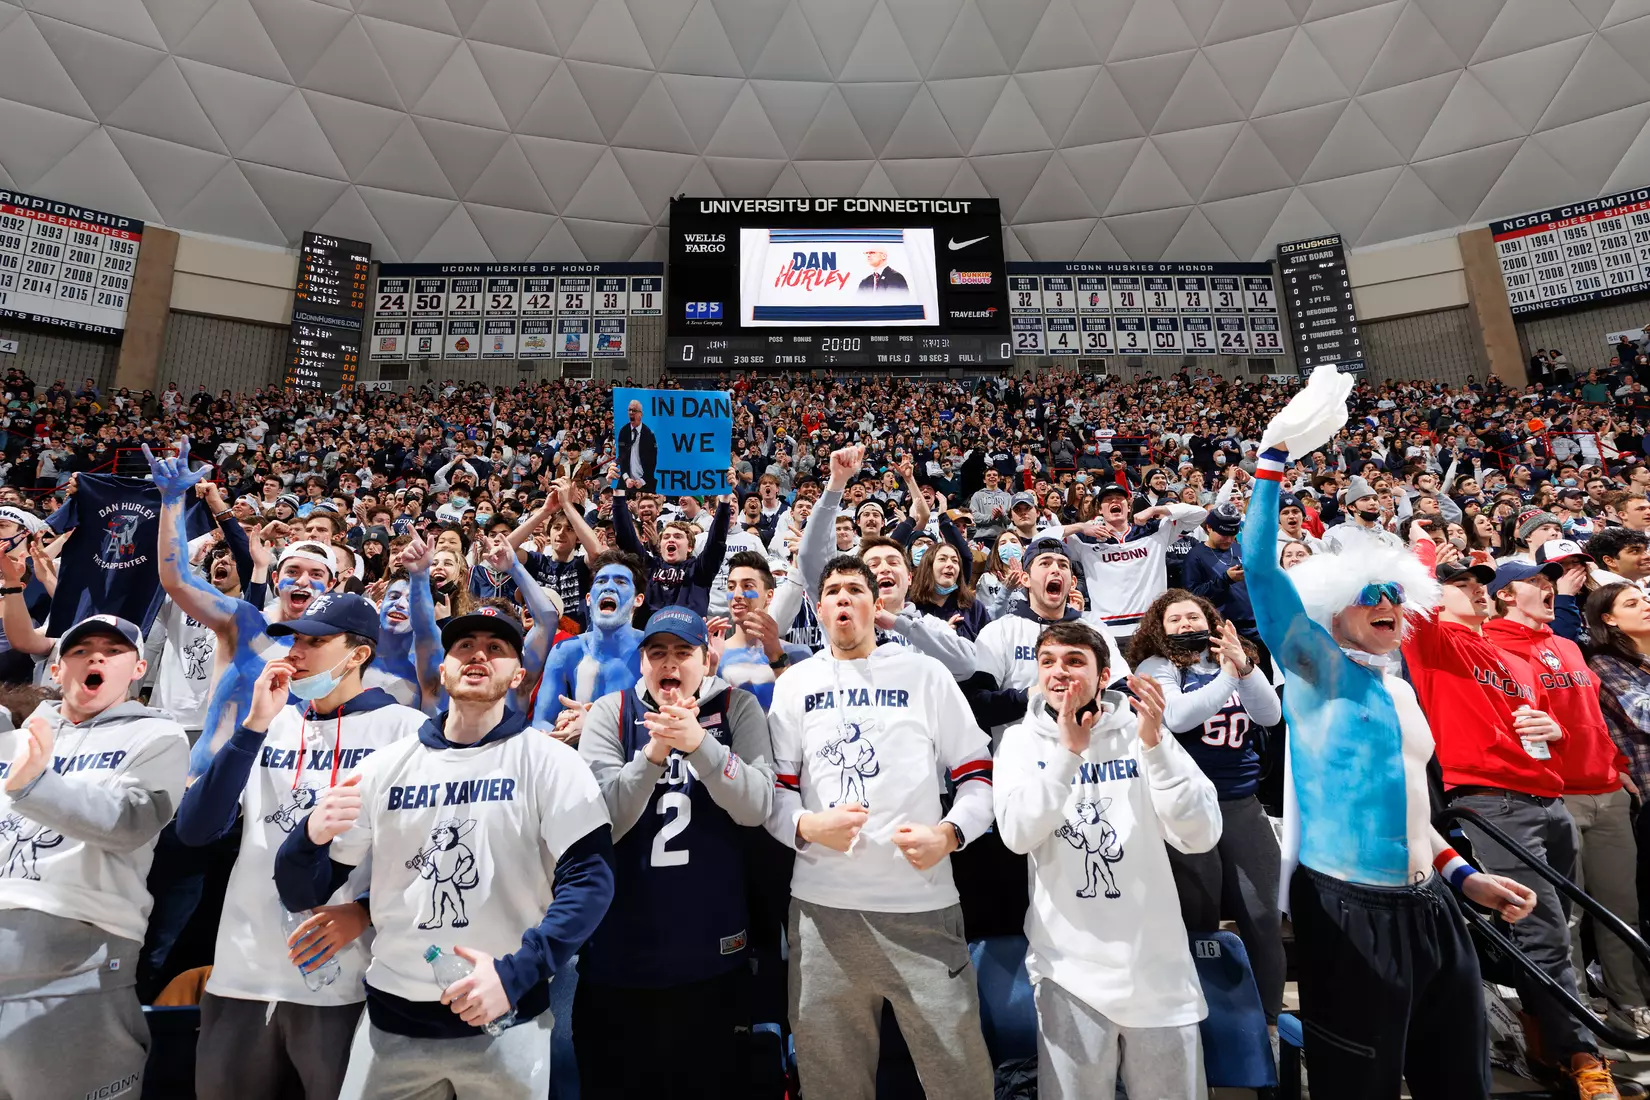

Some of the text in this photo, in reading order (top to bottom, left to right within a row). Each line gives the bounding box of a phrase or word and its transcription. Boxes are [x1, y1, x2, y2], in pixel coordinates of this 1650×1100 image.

[700, 199, 971, 214] UNIVERSITY OF CONNECTICUT
[1503, 190, 1648, 230] NCAA CHAMPIO
[15, 207, 129, 239] APPEARANCES
[1548, 202, 1650, 230] SWEET SIXTE
[36, 224, 62, 240] 1993
[73, 232, 98, 247] 1994
[110, 240, 134, 255] 1995
[684, 234, 726, 242] WELLS
[1500, 240, 1522, 254] 1991
[1531, 234, 1555, 248] 1994
[1563, 226, 1588, 240] 1995
[1598, 218, 1622, 233] 1996
[686, 244, 726, 252] FARGO
[1282, 237, 1338, 252] GO HUSKIES
[30, 242, 132, 272] 2000 2001 2002
[792, 252, 836, 270] DAN
[1290, 250, 1334, 264] STAT BOARD
[1502, 236, 1628, 271] 2000 2001 2002 2003
[26, 260, 129, 290] 2007 2008 2009
[774, 260, 850, 291] HURLEY
[1506, 252, 1632, 287] 2007 2008 2009 2010
[22, 278, 124, 308] 2014 2015 2016
[1510, 270, 1635, 304] 2014 2015 2016 2017
[380, 295, 404, 310] 24
[416, 295, 440, 310] 50
[456, 295, 474, 309] 21
[491, 294, 512, 309] 52
[526, 294, 550, 308] 42
[566, 294, 583, 308] 25
[604, 294, 617, 308] 33
[640, 293, 652, 308] 10
[1018, 292, 1032, 306] 32
[1056, 292, 1062, 306] 3
[1120, 292, 1134, 306] 20
[1154, 292, 1166, 306] 31
[1186, 292, 1200, 306] 23
[1220, 292, 1234, 306] 31
[1252, 292, 1268, 306] 14
[1512, 293, 1595, 314] CONNECTICUT
[686, 302, 720, 312] CBS
[1306, 306, 1338, 316] REBOUNDS
[32, 314, 116, 335] BASKETBALL
[1312, 318, 1336, 326] ASSISTS
[1018, 333, 1038, 348] 23
[1058, 333, 1068, 348] 4
[1088, 332, 1108, 348] 30
[1127, 332, 1136, 347] 3
[1156, 332, 1175, 347] CD
[1192, 332, 1206, 347] 15
[1221, 332, 1244, 347] 24
[1256, 332, 1278, 347] 33
[1310, 329, 1344, 339] TURNOVERS
[822, 338, 860, 350] 20:00
[1001, 343, 1010, 358] 0
[1316, 342, 1340, 350] BLOCKS
[683, 345, 694, 361] 0
[889, 354, 902, 362] FLS
[919, 354, 928, 362] 30
[929, 354, 942, 362] SEC
[959, 354, 974, 362] FULL
[1320, 354, 1341, 362] STEALS
[374, 382, 391, 392] 201
[652, 397, 730, 418] IN DAN
[672, 432, 714, 452] WE
[656, 470, 730, 490] TRUST
[98, 502, 156, 520] DAN HURLEY
[1102, 548, 1148, 562] UCONN
[1014, 646, 1037, 660] BEA
[1538, 670, 1592, 689] CONN
[1201, 712, 1250, 748] 50
[260, 746, 306, 770] BEAT
[388, 778, 516, 810] BEAT XAVIER
[650, 792, 692, 867] 2
[1200, 942, 1215, 956] 16
[86, 1072, 140, 1100] UCONN
